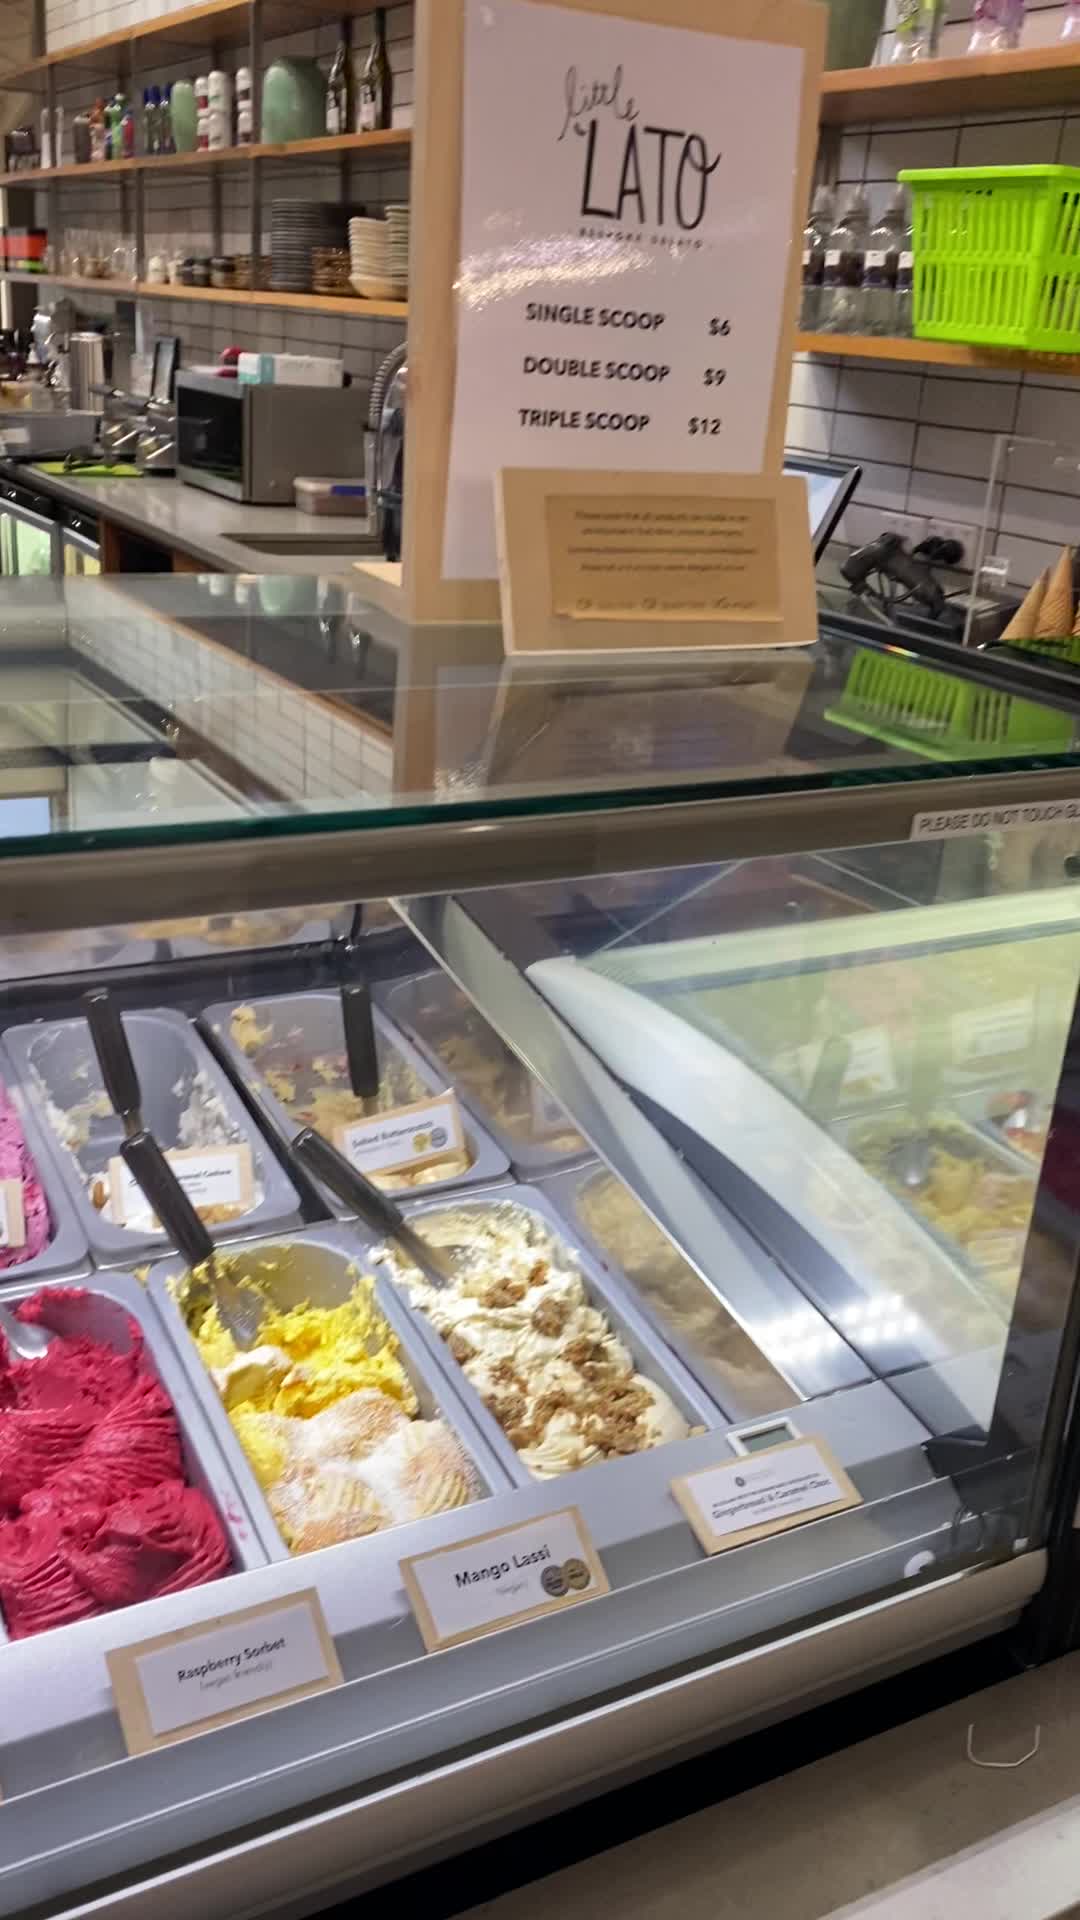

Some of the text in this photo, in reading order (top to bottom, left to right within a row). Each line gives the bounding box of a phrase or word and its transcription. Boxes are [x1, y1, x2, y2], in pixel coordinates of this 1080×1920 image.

[558, 64, 640, 141] little
[575, 119, 722, 230] LATO
[525, 302, 732, 337] SINGLE SCOOP $6
[523, 356, 727, 386] DOUBLE SCOOP $9
[518, 408, 722, 435] TRIPLE SCOOP $12
[919, 813, 970, 833] PLEASE
[972, 811, 992, 829] DO
[993, 809, 1019, 826] NOT
[1022, 806, 1063, 823] TOUCH
[453, 1561, 511, 1589] Mango
[512, 1544, 552, 1569] Lassi
[177, 1637, 287, 1683] Raspberry Sorbet
